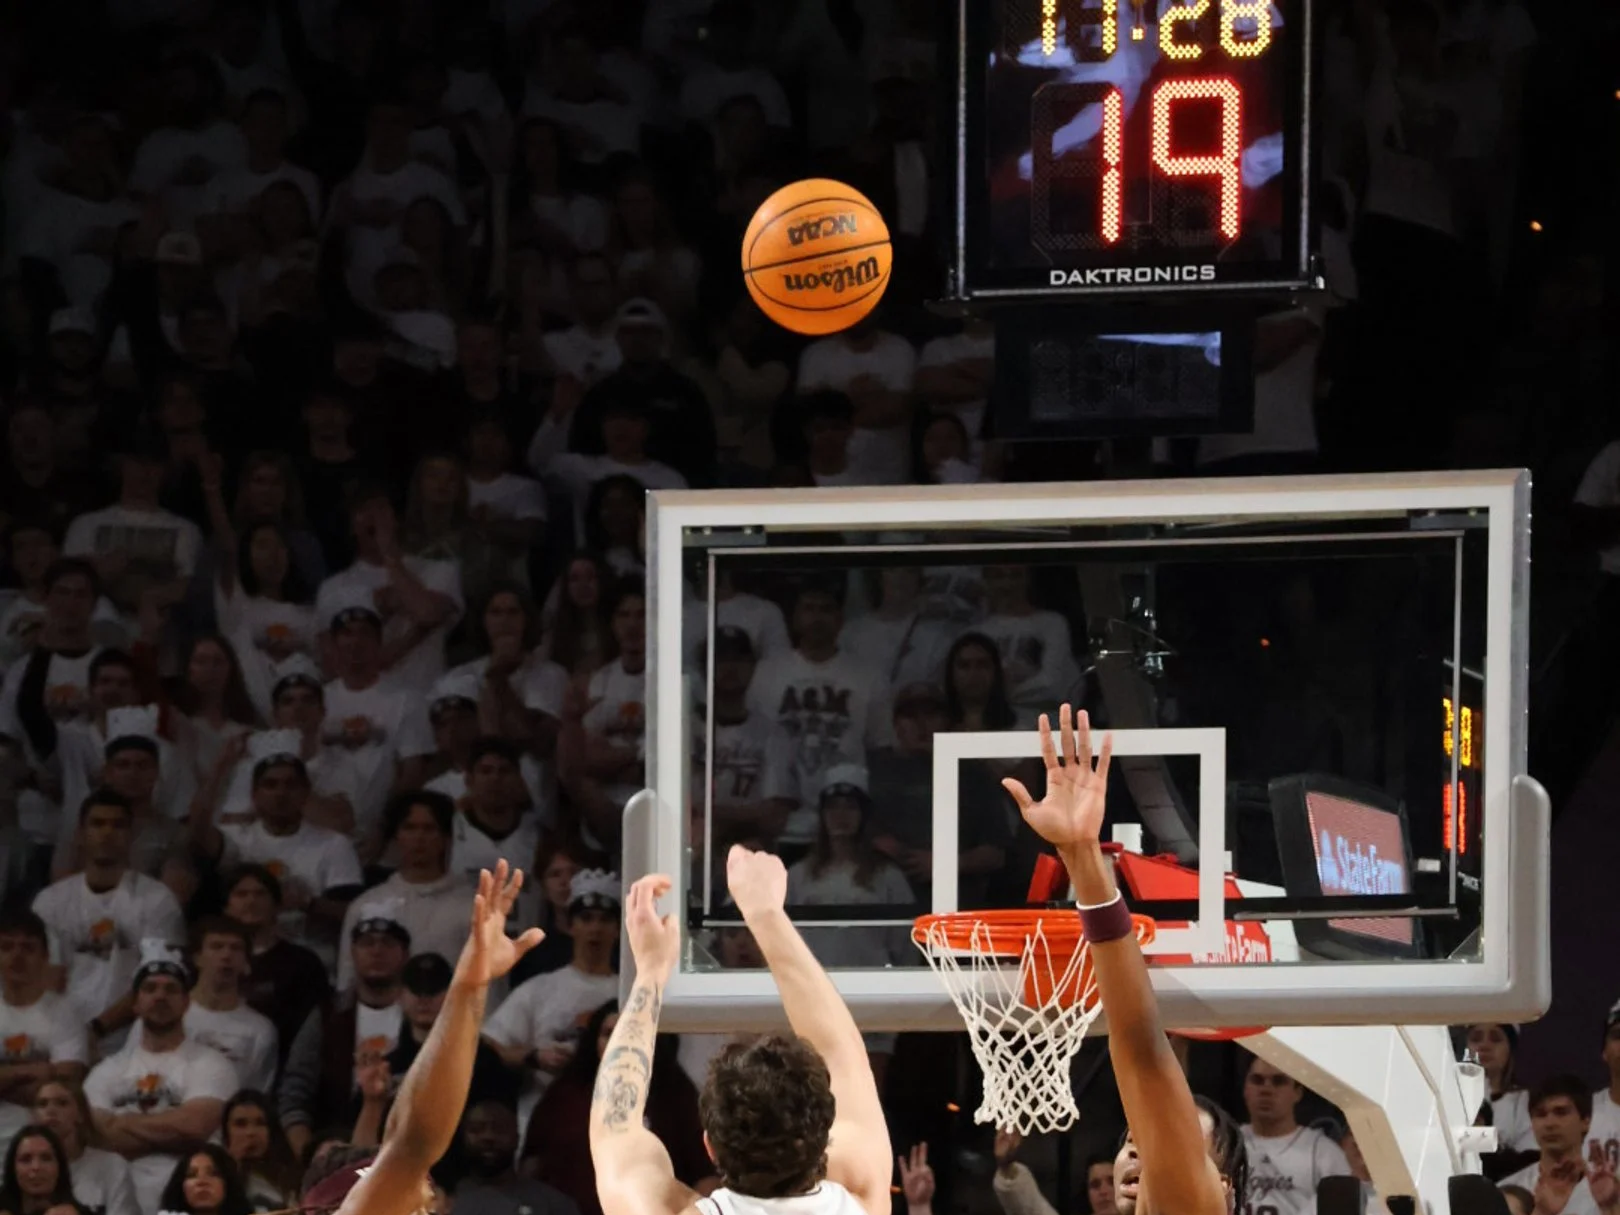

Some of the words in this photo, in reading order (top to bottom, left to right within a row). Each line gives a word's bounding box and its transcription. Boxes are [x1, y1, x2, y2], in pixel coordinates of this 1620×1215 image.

[1102, 79, 1241, 242] 19
[787, 214, 857, 246] NCAA
[784, 256, 880, 293] Wilson
[1050, 265, 1215, 285] DAKTRONICS
